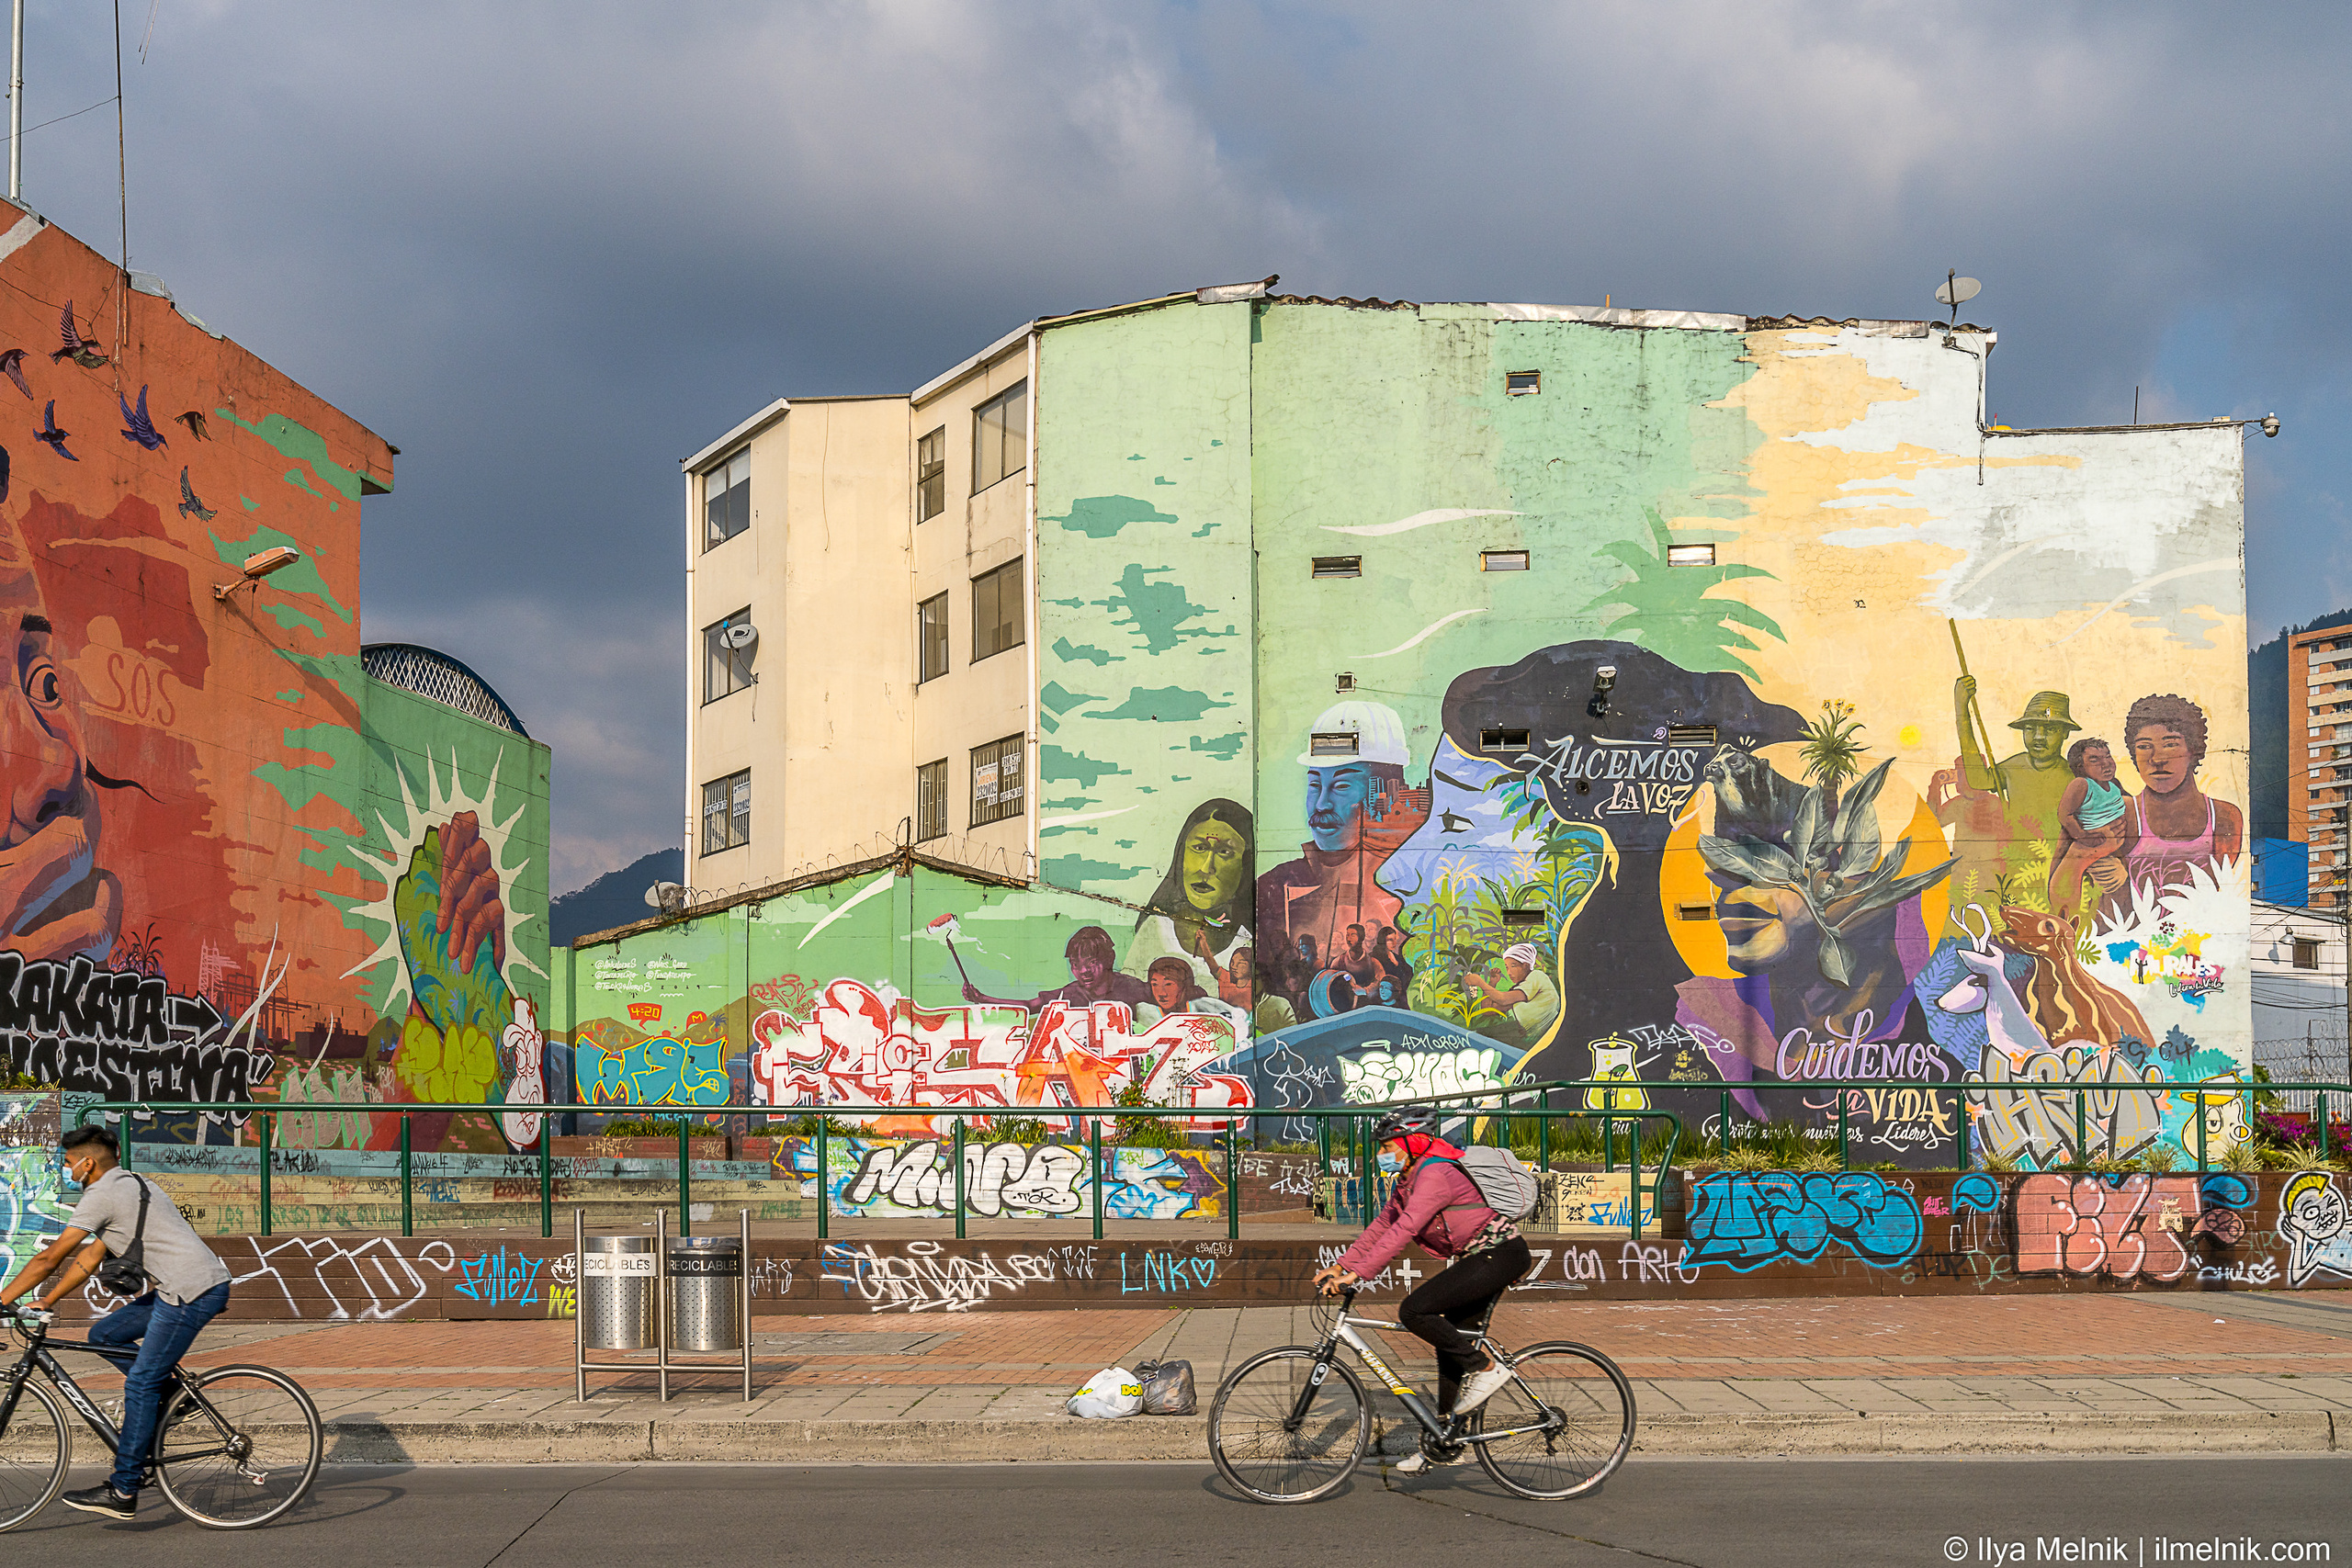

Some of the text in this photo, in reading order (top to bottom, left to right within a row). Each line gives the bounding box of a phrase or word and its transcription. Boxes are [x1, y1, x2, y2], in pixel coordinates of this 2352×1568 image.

[1514, 734, 1699, 801] ALCEMOS
[1594, 780, 1707, 830] LA VOZ
[631, 1006, 660, 1019] 4:20
[584, 1258, 650, 1270] ECICLABLES
[1121, 1252, 1191, 1296] LNK
